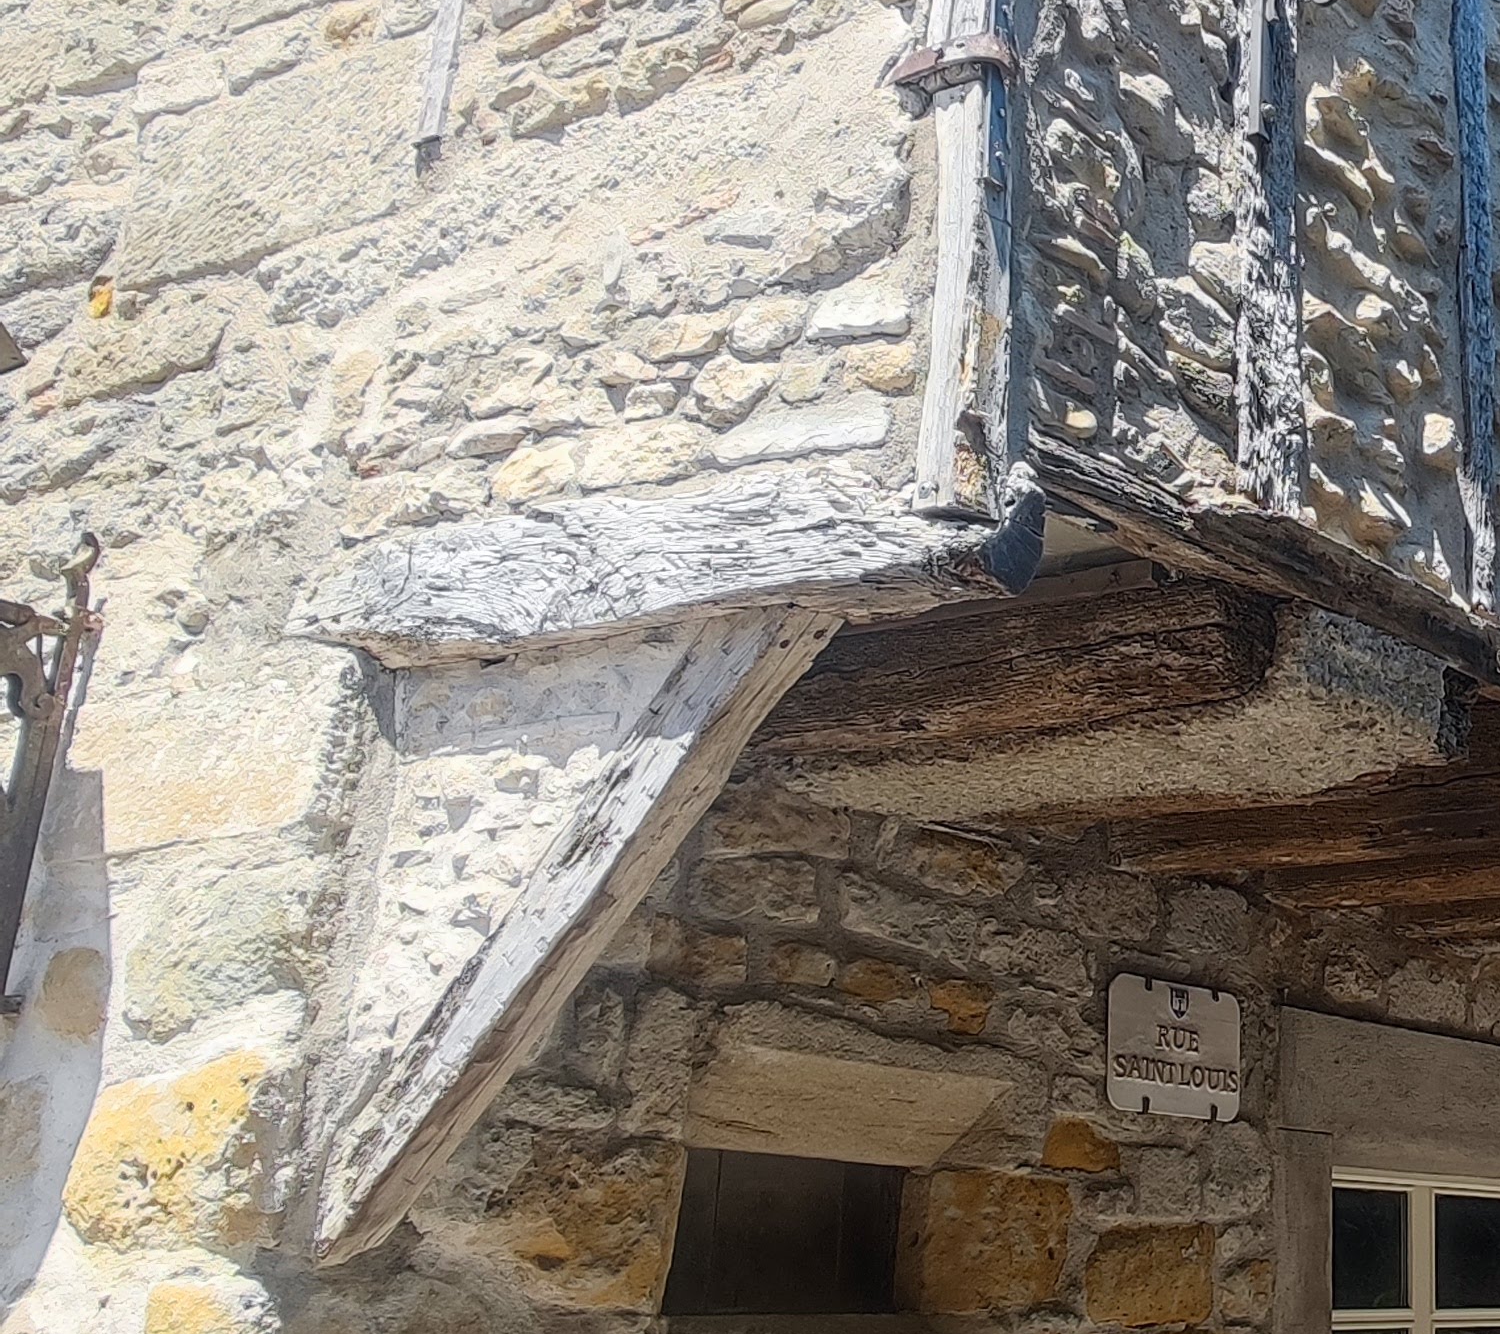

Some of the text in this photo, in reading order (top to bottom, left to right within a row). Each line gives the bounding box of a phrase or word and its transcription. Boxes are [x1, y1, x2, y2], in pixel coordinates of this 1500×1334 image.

[1155, 1024, 1199, 1055] RUE
[1113, 1054, 1238, 1094] SAINT LOUIS
